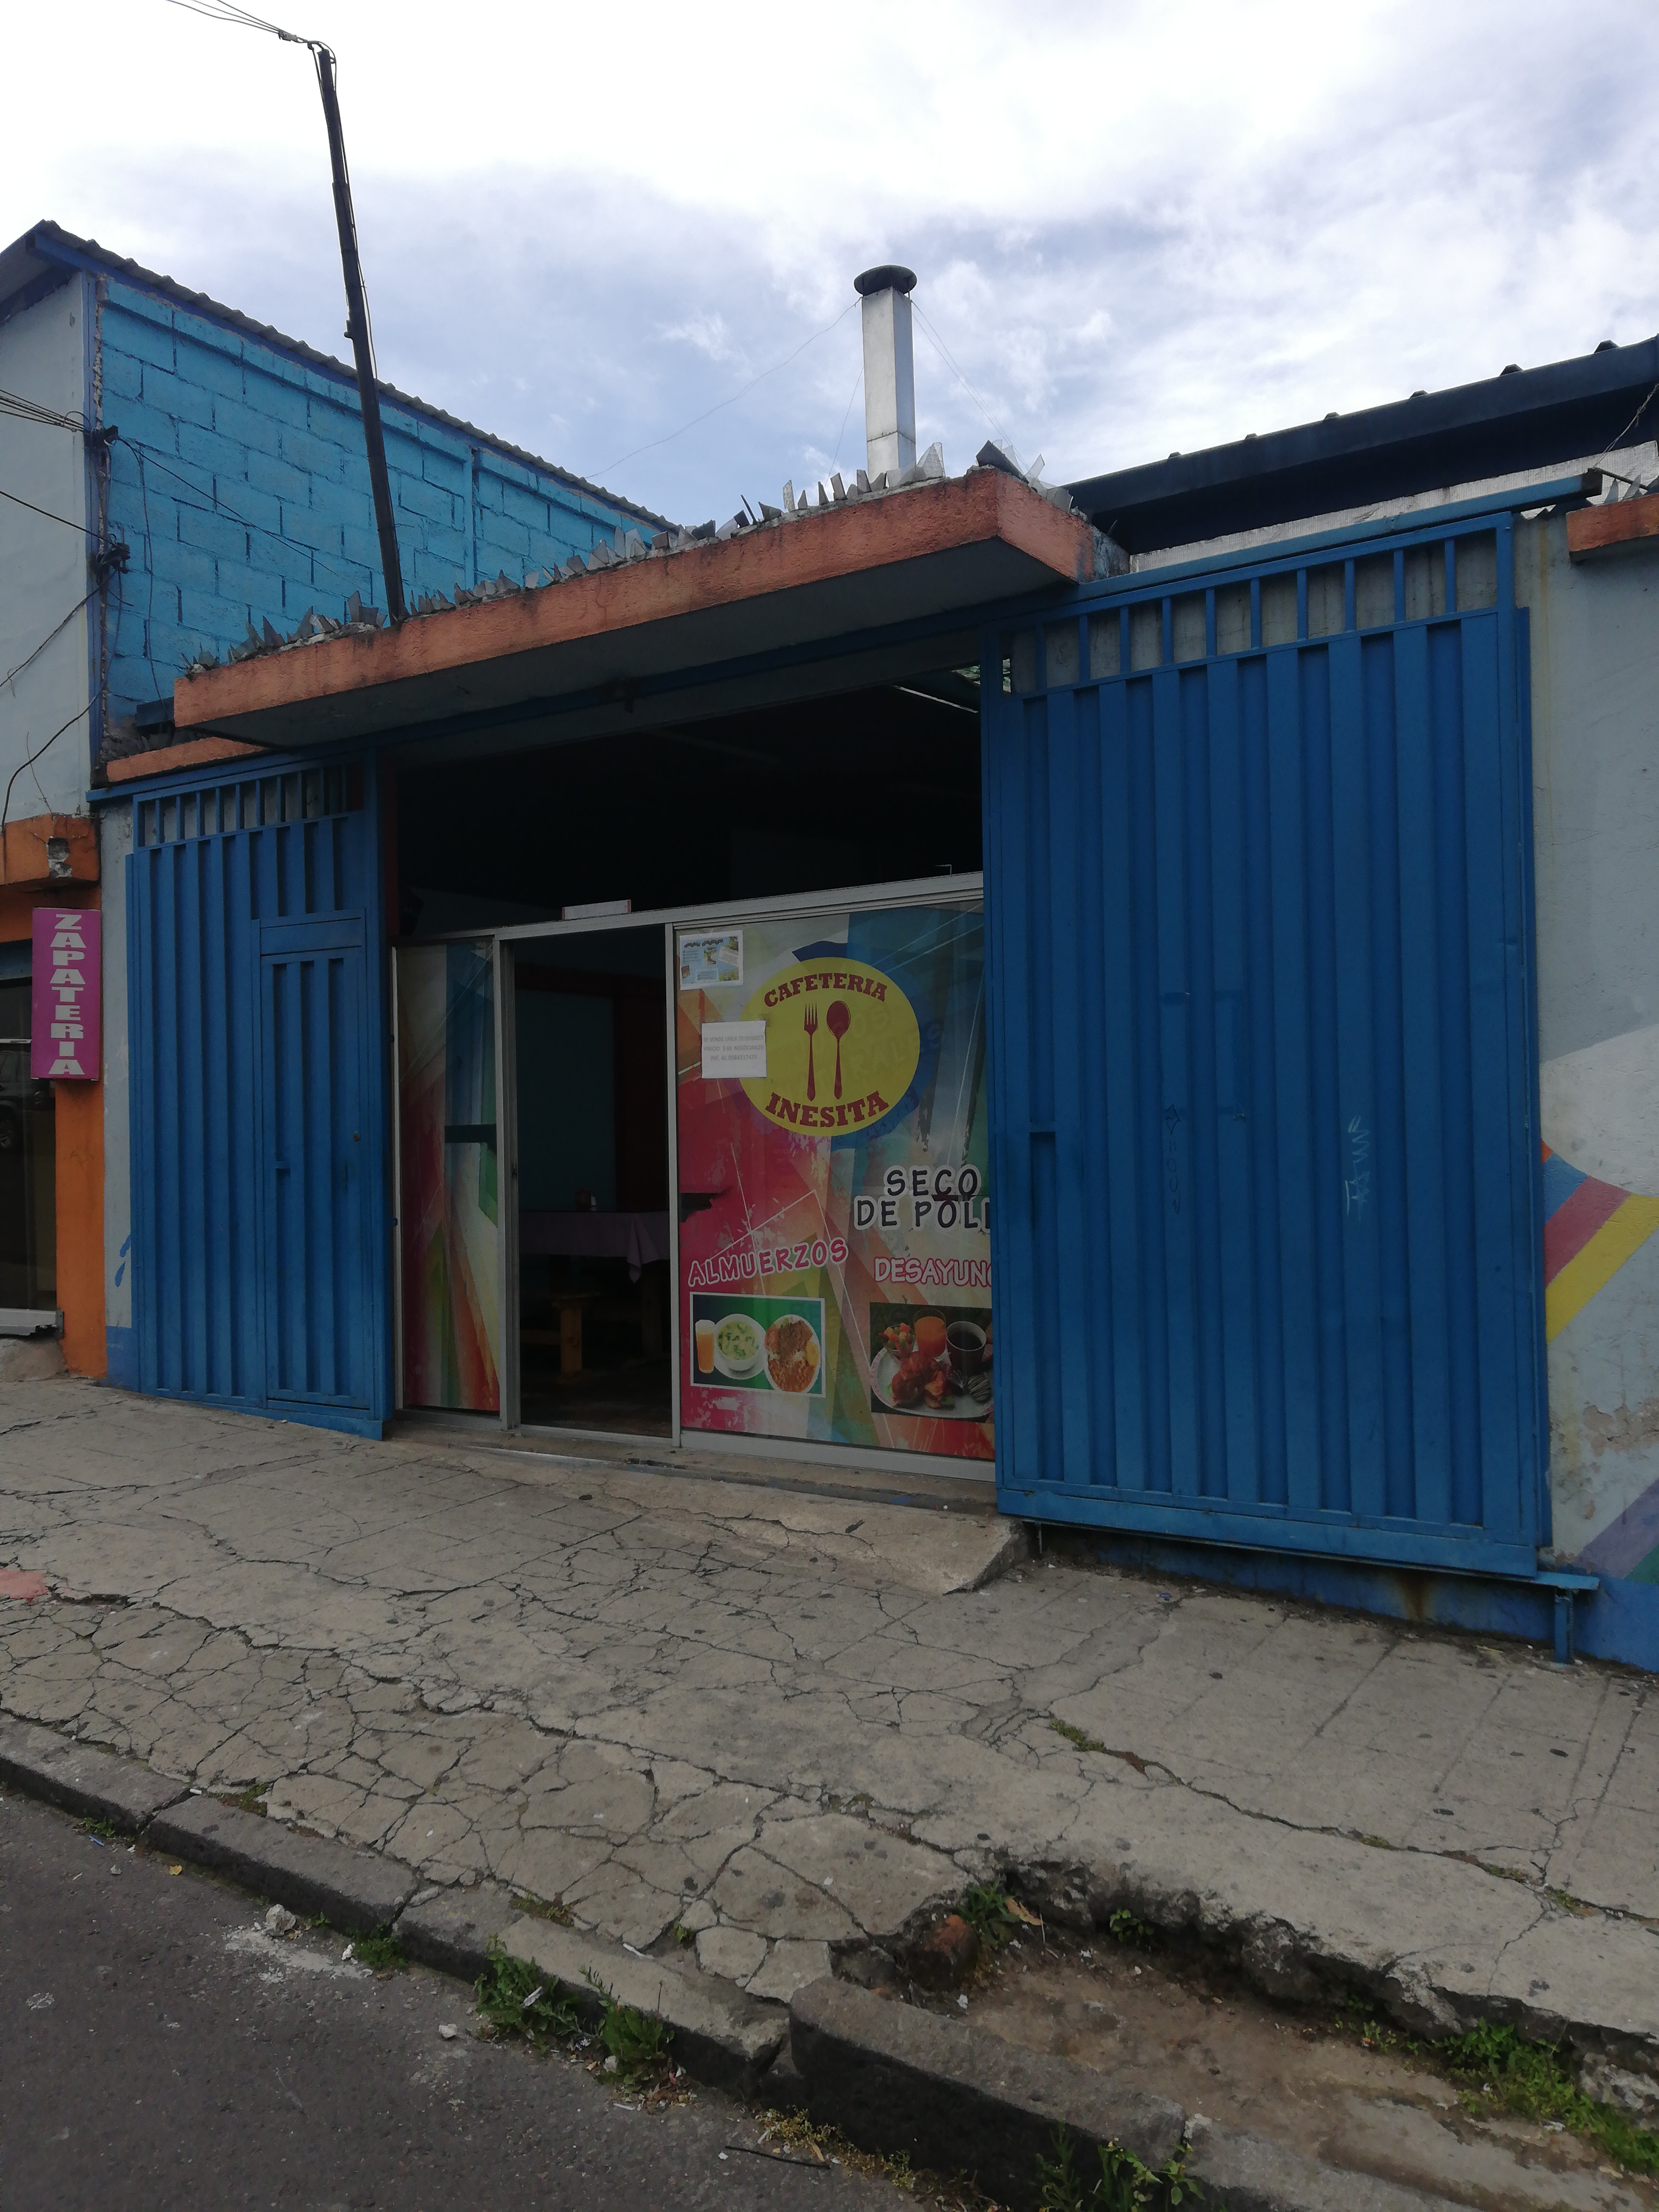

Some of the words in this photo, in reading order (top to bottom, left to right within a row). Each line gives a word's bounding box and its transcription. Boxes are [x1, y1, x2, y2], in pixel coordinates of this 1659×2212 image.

[48, 914, 86, 1075] ZAPATERIA
[764, 973, 887, 1007] CAFETERIA
[765, 1090, 889, 1128] INESITA
[886, 1168, 978, 1196] SECO
[856, 1200, 897, 1227] DE
[688, 1237, 849, 1287] ALMUERZOS
[874, 1257, 992, 1287] DESAYUN
